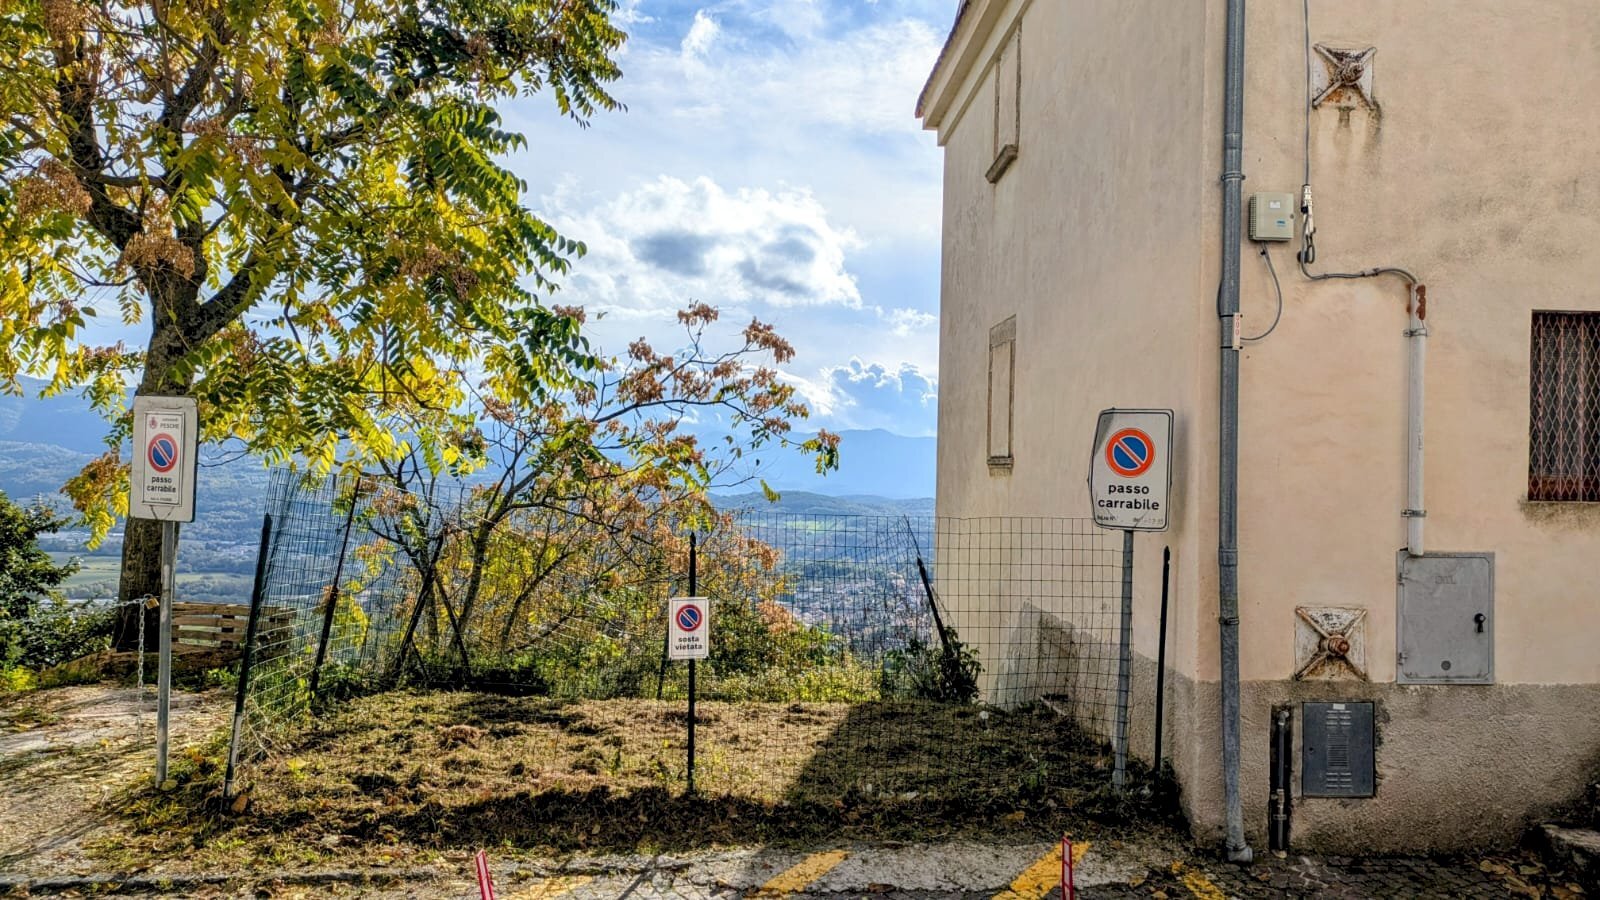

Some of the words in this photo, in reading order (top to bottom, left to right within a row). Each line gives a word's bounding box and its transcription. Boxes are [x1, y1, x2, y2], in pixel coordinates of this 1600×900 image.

[151, 476, 172, 484] passo
[146, 485, 176, 493] carrabile
[1108, 484, 1150, 495] passo
[1097, 499, 1160, 510] carrabile
